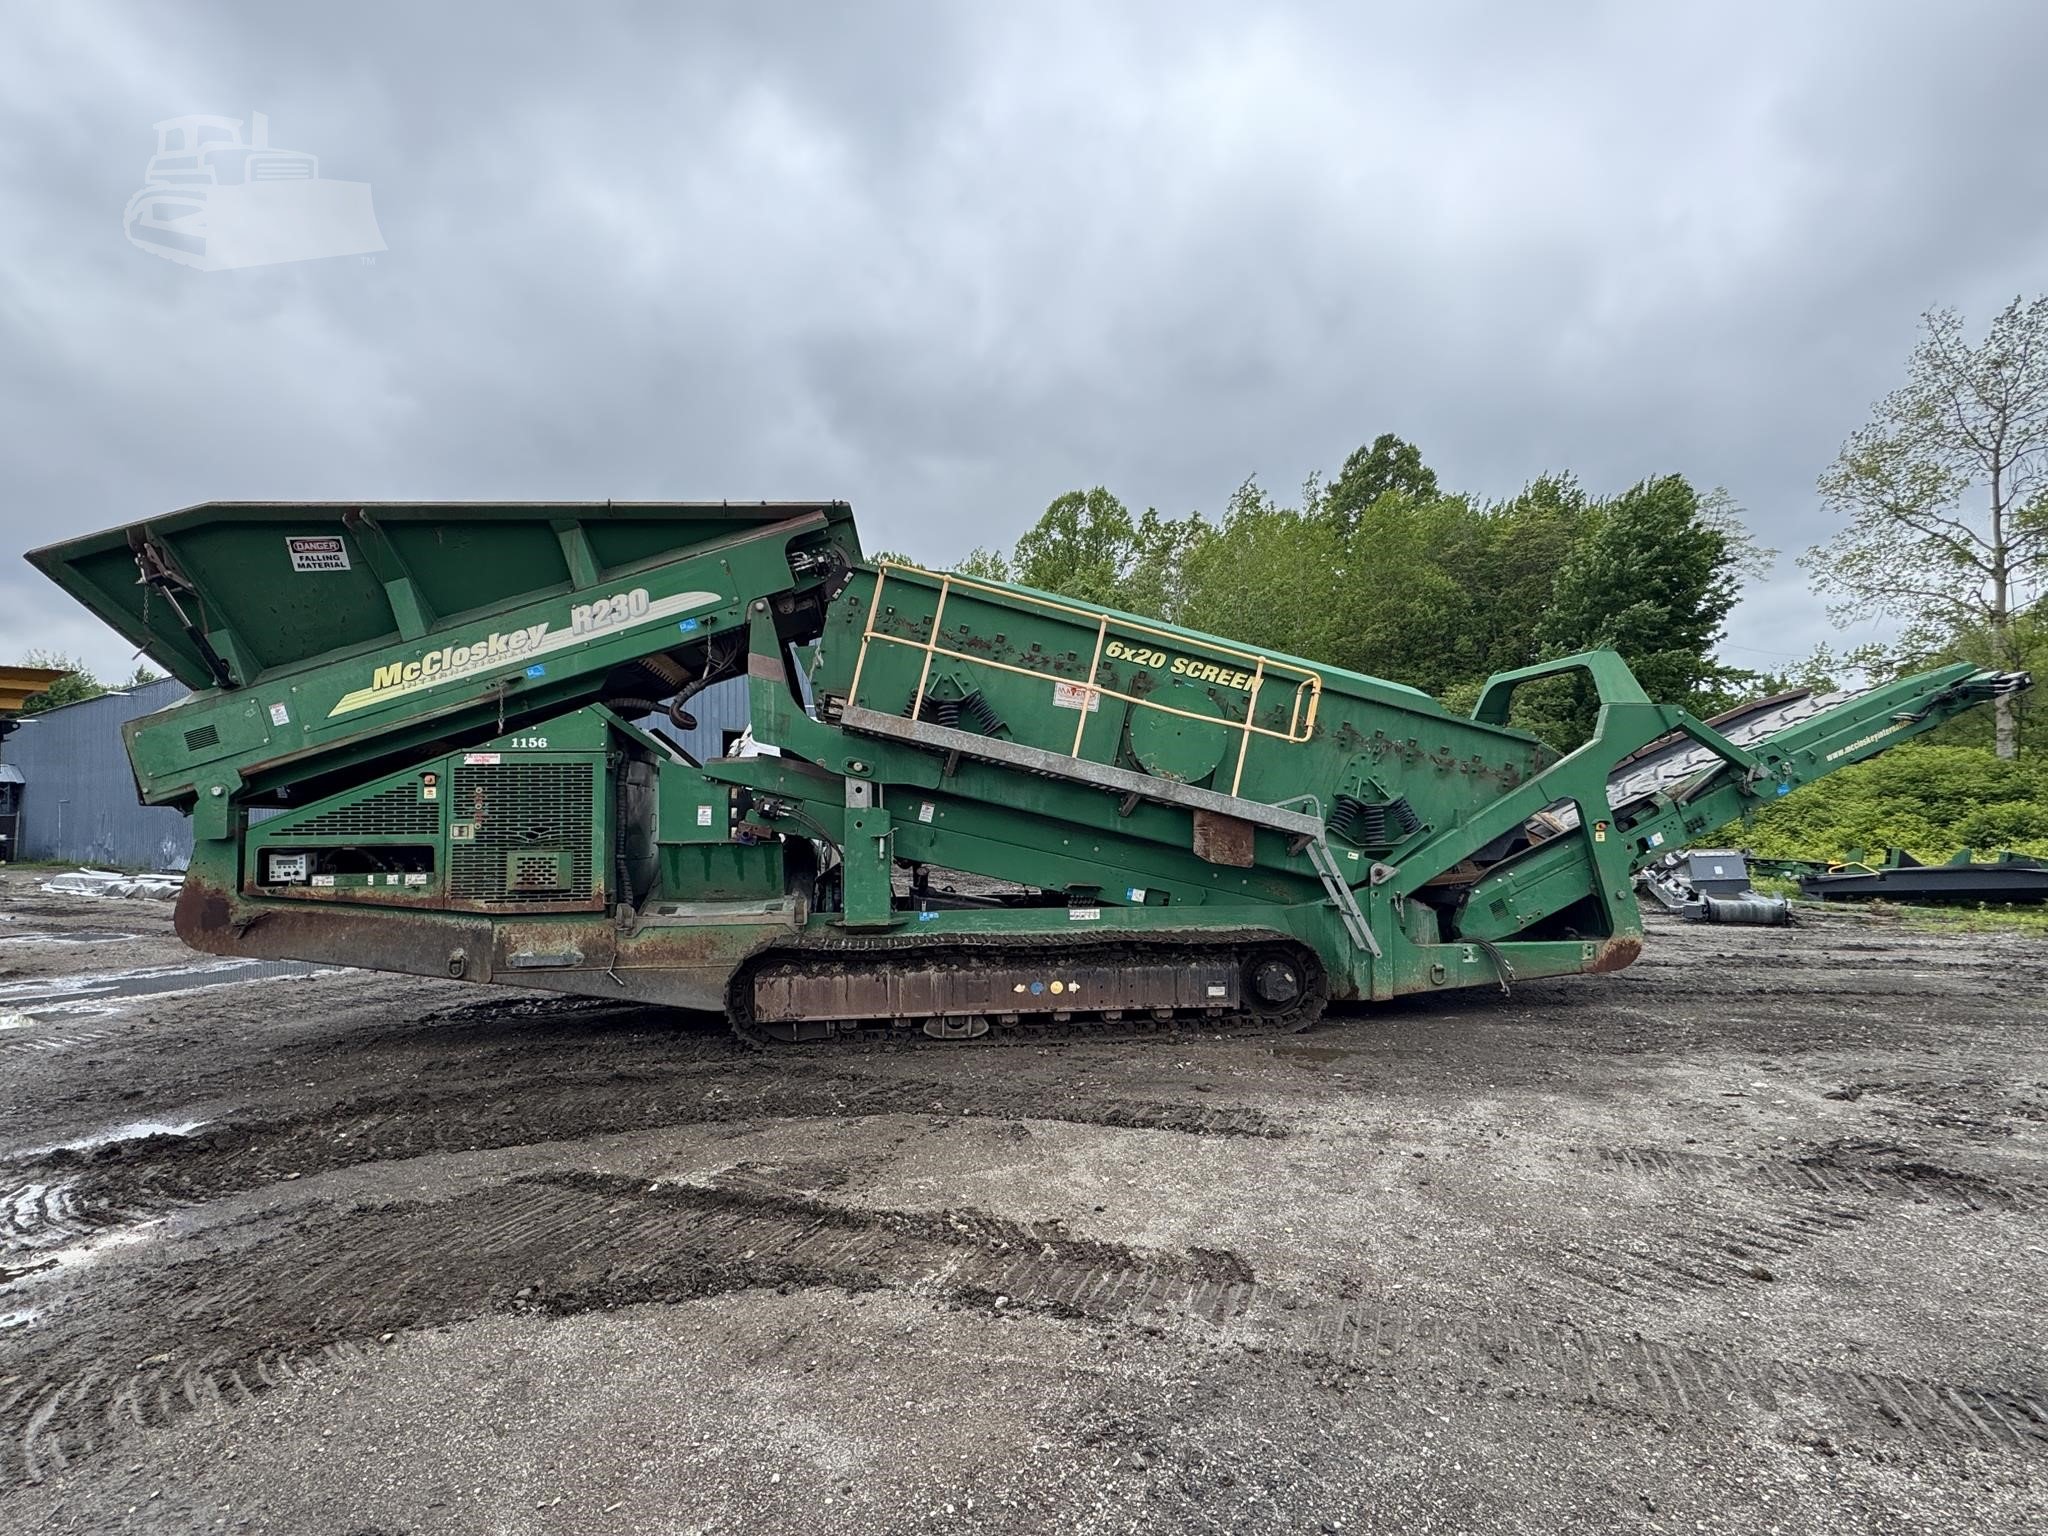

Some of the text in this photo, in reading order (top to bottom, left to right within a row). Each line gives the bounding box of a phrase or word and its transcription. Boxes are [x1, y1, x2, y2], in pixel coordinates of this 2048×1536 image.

[296, 542, 338, 551] DANGER
[299, 554, 341, 562] FALLING
[297, 561, 346, 569] MATERIAL
[372, 587, 650, 692] McCloskey R230
[1105, 641, 1167, 669] 6x20
[401, 648, 529, 691] INTERNATIONAL
[511, 737, 548, 748] 1156
